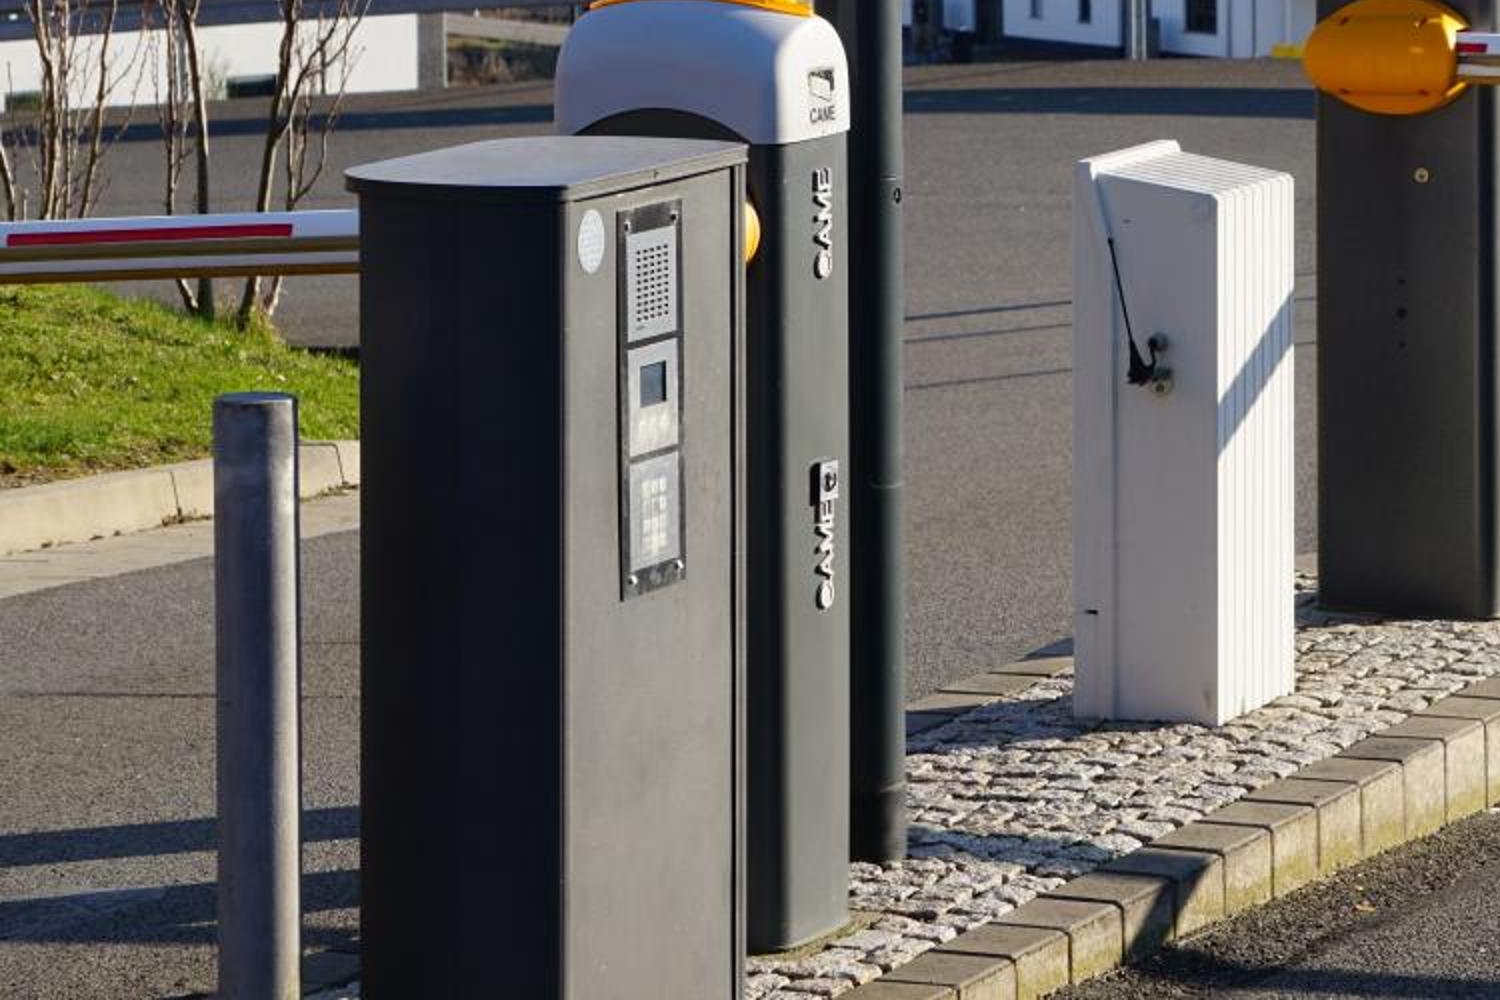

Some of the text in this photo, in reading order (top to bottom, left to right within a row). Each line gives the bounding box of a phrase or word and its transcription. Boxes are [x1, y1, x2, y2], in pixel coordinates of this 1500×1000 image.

[810, 105, 835, 123] CAME
[813, 168, 832, 279] CAME
[815, 499, 835, 610] CAME
